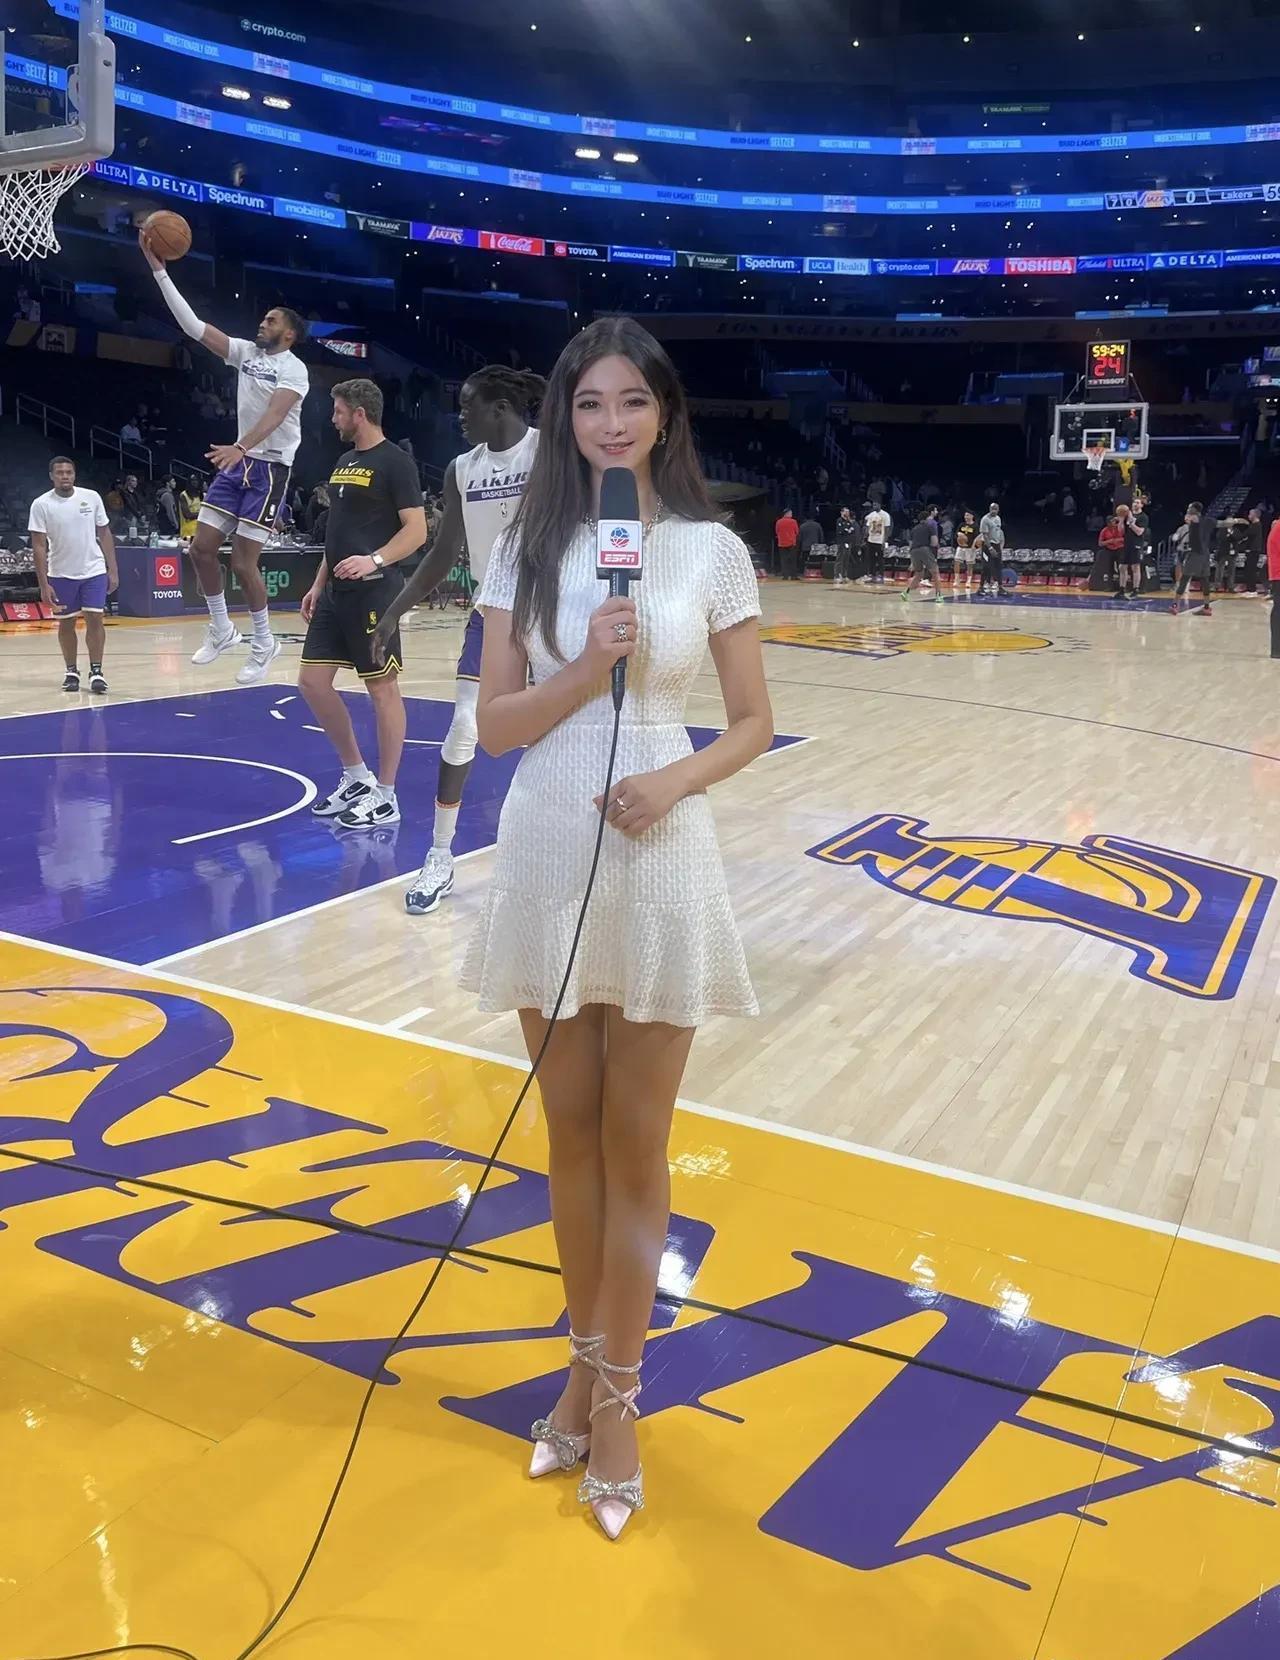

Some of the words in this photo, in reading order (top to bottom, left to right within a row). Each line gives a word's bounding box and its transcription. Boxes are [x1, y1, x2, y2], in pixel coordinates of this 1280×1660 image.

[110, 15, 137, 34] SELTZER
[251, 22, 306, 43] crypto.com
[6, 60, 25, 72] GHT
[25, 63, 58, 84] SELTZER
[95, 162, 128, 180] ULTRA
[152, 177, 196, 196] DELTA
[208, 188, 264, 209] Spectrum
[1185, 191, 1196, 204] 0
[1221, 190, 1253, 200] Lakers
[427, 226, 464, 245] LAKERS
[568, 247, 598, 257] TOYOTA
[613, 251, 644, 260] AMERICAN
[645, 253, 671, 262] EXPRESS
[1226, 254, 1260, 262] AMERICAN
[744, 257, 796, 271] Spectrum
[811, 261, 832, 271] UCLA
[836, 260, 867, 273] Health
[1008, 259, 1072, 273] TOSHIBA
[1113, 258, 1145, 268] ULTRA
[1169, 254, 1217, 266] DELTA
[888, 262, 930, 273] crypto.com
[1092, 344, 1125, 358] 59:24
[1094, 357, 1121, 377] 24
[1098, 377, 1126, 385] TISSOT
[332, 467, 374, 477] LAKERS
[467, 471, 529, 490] LAKER
[481, 486, 522, 499] BASKETBALL
[604, 553, 636, 564] ESPN
[152, 590, 183, 599] TOYOTA
